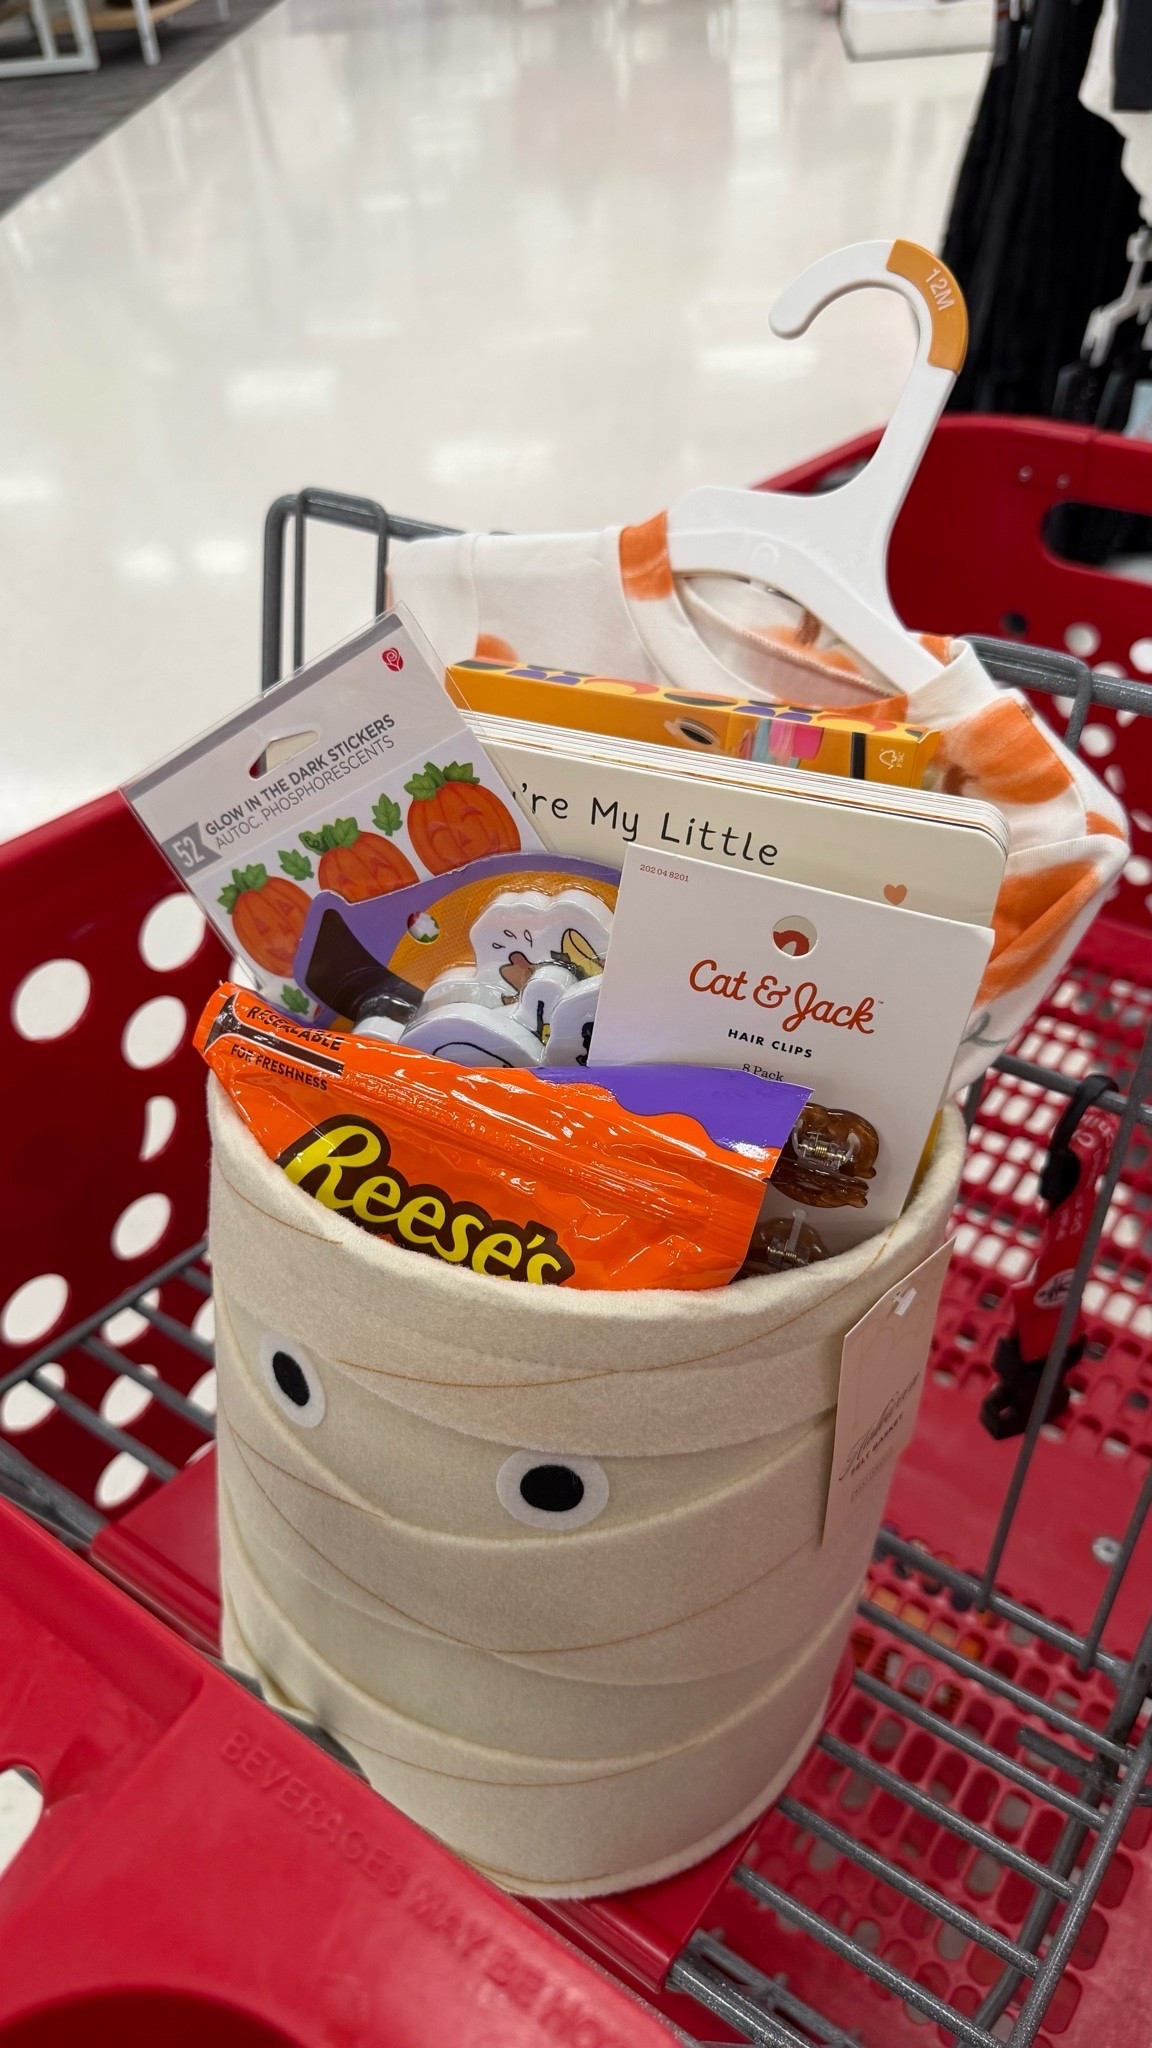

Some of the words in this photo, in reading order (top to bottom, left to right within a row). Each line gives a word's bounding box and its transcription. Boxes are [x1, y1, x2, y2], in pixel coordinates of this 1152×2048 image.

[925, 268, 955, 311] 12M
[205, 805, 245, 836] GLOW
[244, 793, 260, 812] IN
[260, 778, 291, 806] THE
[288, 755, 329, 789] DARK
[327, 714, 395, 761] STICKERS
[216, 817, 264, 850] AUTOC.
[262, 735, 395, 822] PHOSPHORESCENTS
[172, 835, 205, 868] 52
[591, 797, 639, 842] My
[660, 812, 779, 866] Little
[689, 959, 748, 1001] Cat
[752, 975, 792, 1009] &
[782, 982, 875, 1035] Jack
[246, 1006, 345, 1051] RESEALABLE
[727, 1028, 765, 1046] HAIR
[771, 1040, 813, 1059] CLIPS
[231, 1044, 254, 1062] FOR
[255, 1054, 328, 1091] FRESHNESS
[742, 1063, 751, 1073] 8
[753, 1065, 785, 1082] Pack
[284, 1125, 561, 1285] Reese's
[220, 1730, 403, 1896] BEVERAGES
